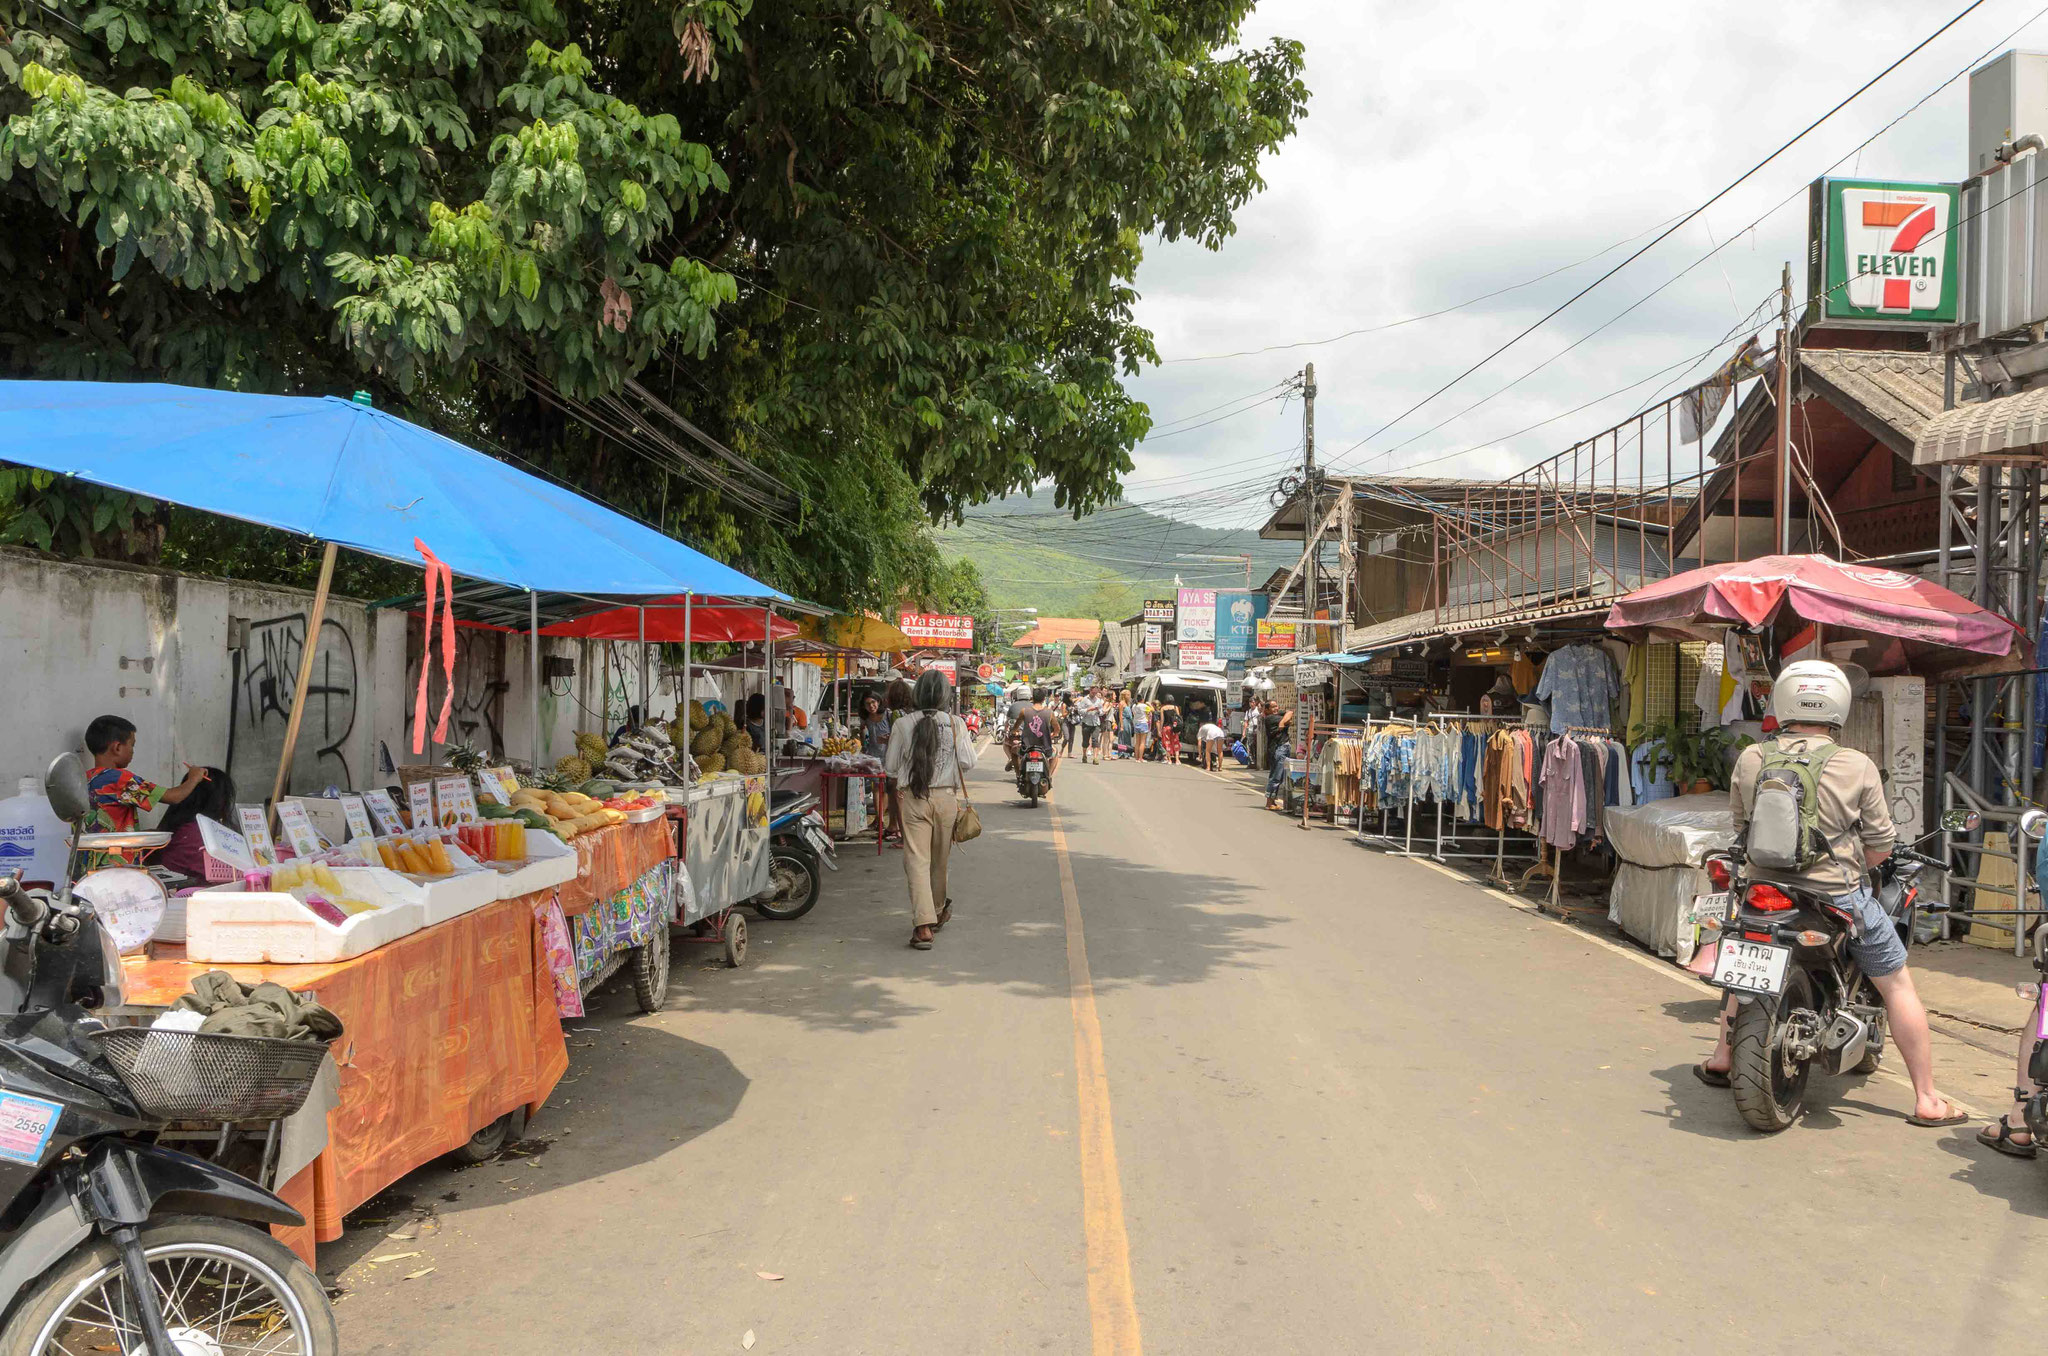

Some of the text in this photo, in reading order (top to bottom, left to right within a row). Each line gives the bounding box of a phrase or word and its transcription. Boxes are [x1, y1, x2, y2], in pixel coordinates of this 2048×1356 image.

[1862, 201, 1936, 309] 7
[1182, 592, 1199, 604] AYA
[903, 615, 926, 626] aYa
[1183, 618, 1210, 626] TICKET
[906, 627, 924, 635] Rent
[932, 628, 968, 638] Motorbike
[1231, 625, 1254, 635] KTB
[1298, 670, 1317, 680] TAXI
[1800, 701, 1823, 709] INDEX
[1734, 959, 1768, 973] เชียงใหม่
[1723, 970, 1771, 990] 6713
[14, 1118, 46, 1135] 2559
